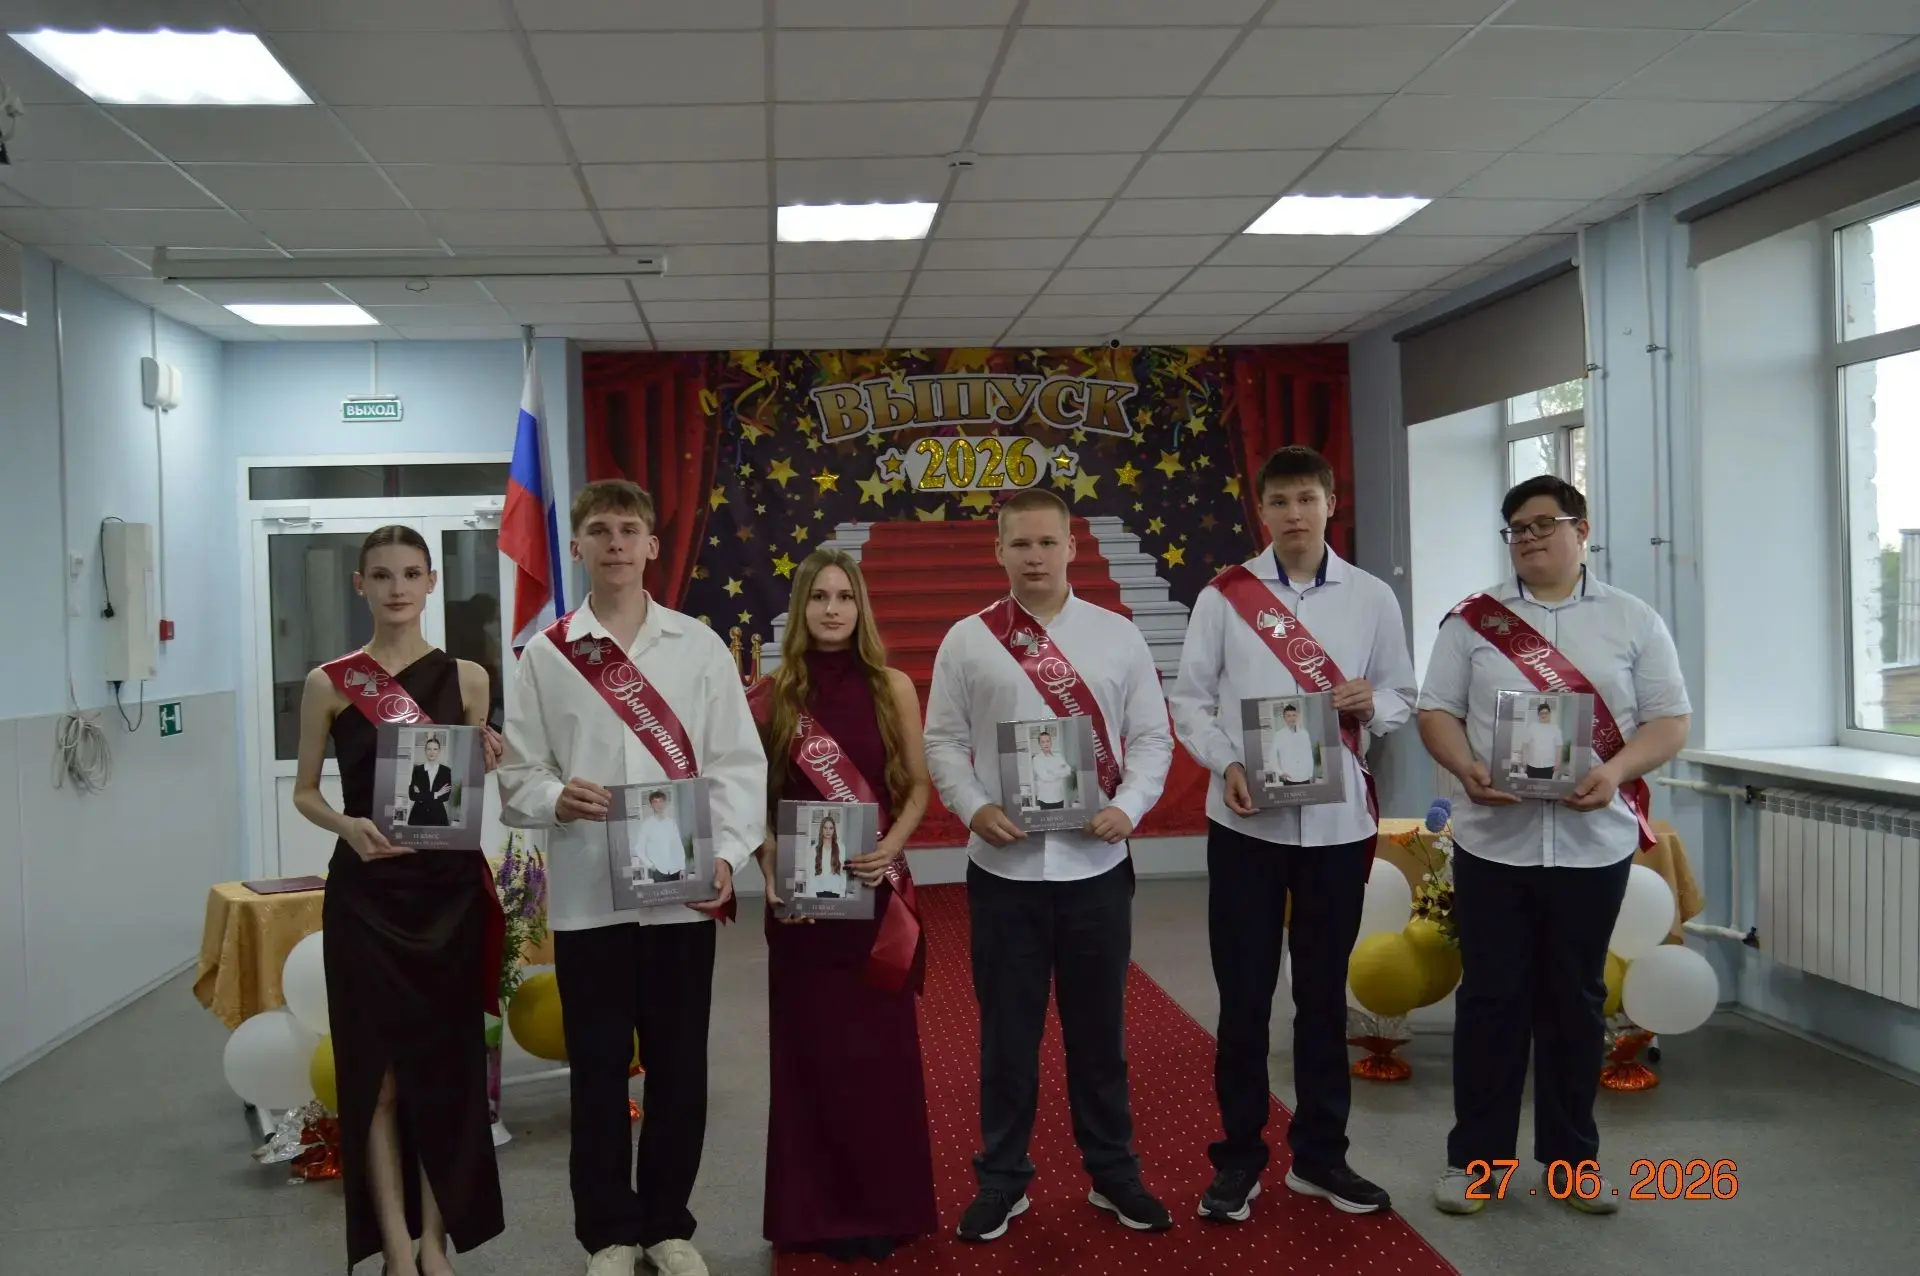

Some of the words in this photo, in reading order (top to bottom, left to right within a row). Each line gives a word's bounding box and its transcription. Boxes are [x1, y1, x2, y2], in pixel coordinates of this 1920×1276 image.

[346, 404, 397, 416] ВЫХОД
[811, 374, 1138, 442] ВЫПУСК
[916, 437, 1038, 489] 2026
[601, 661, 690, 771] Выпускник
